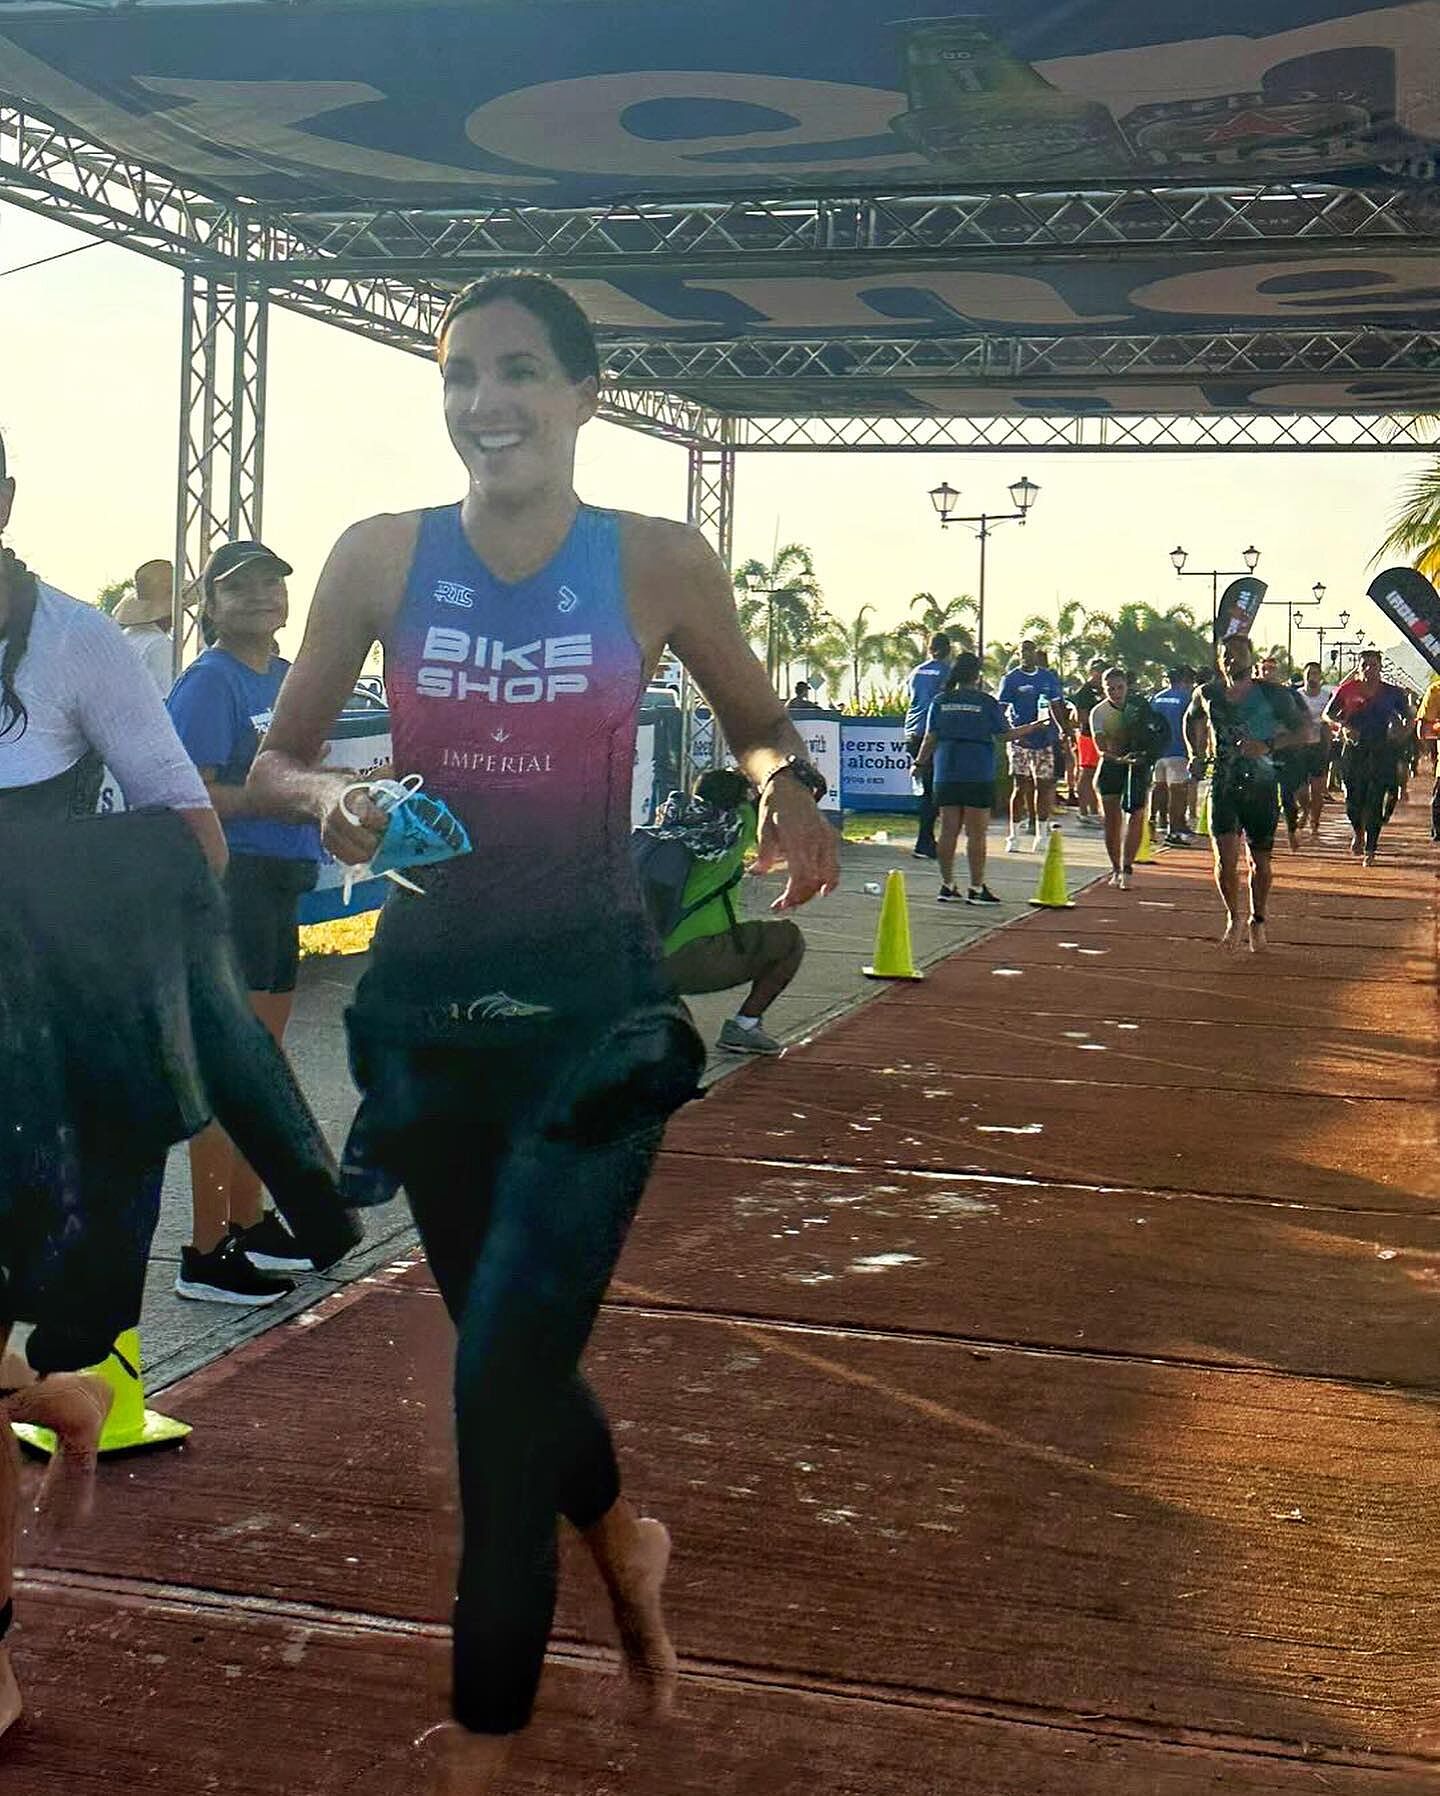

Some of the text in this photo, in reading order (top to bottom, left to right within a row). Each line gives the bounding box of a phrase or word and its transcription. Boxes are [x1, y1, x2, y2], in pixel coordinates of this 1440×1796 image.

[424, 627, 593, 671] BIKE
[417, 667, 589, 703] SHOP
[443, 749, 553, 773] IMPERIAL
